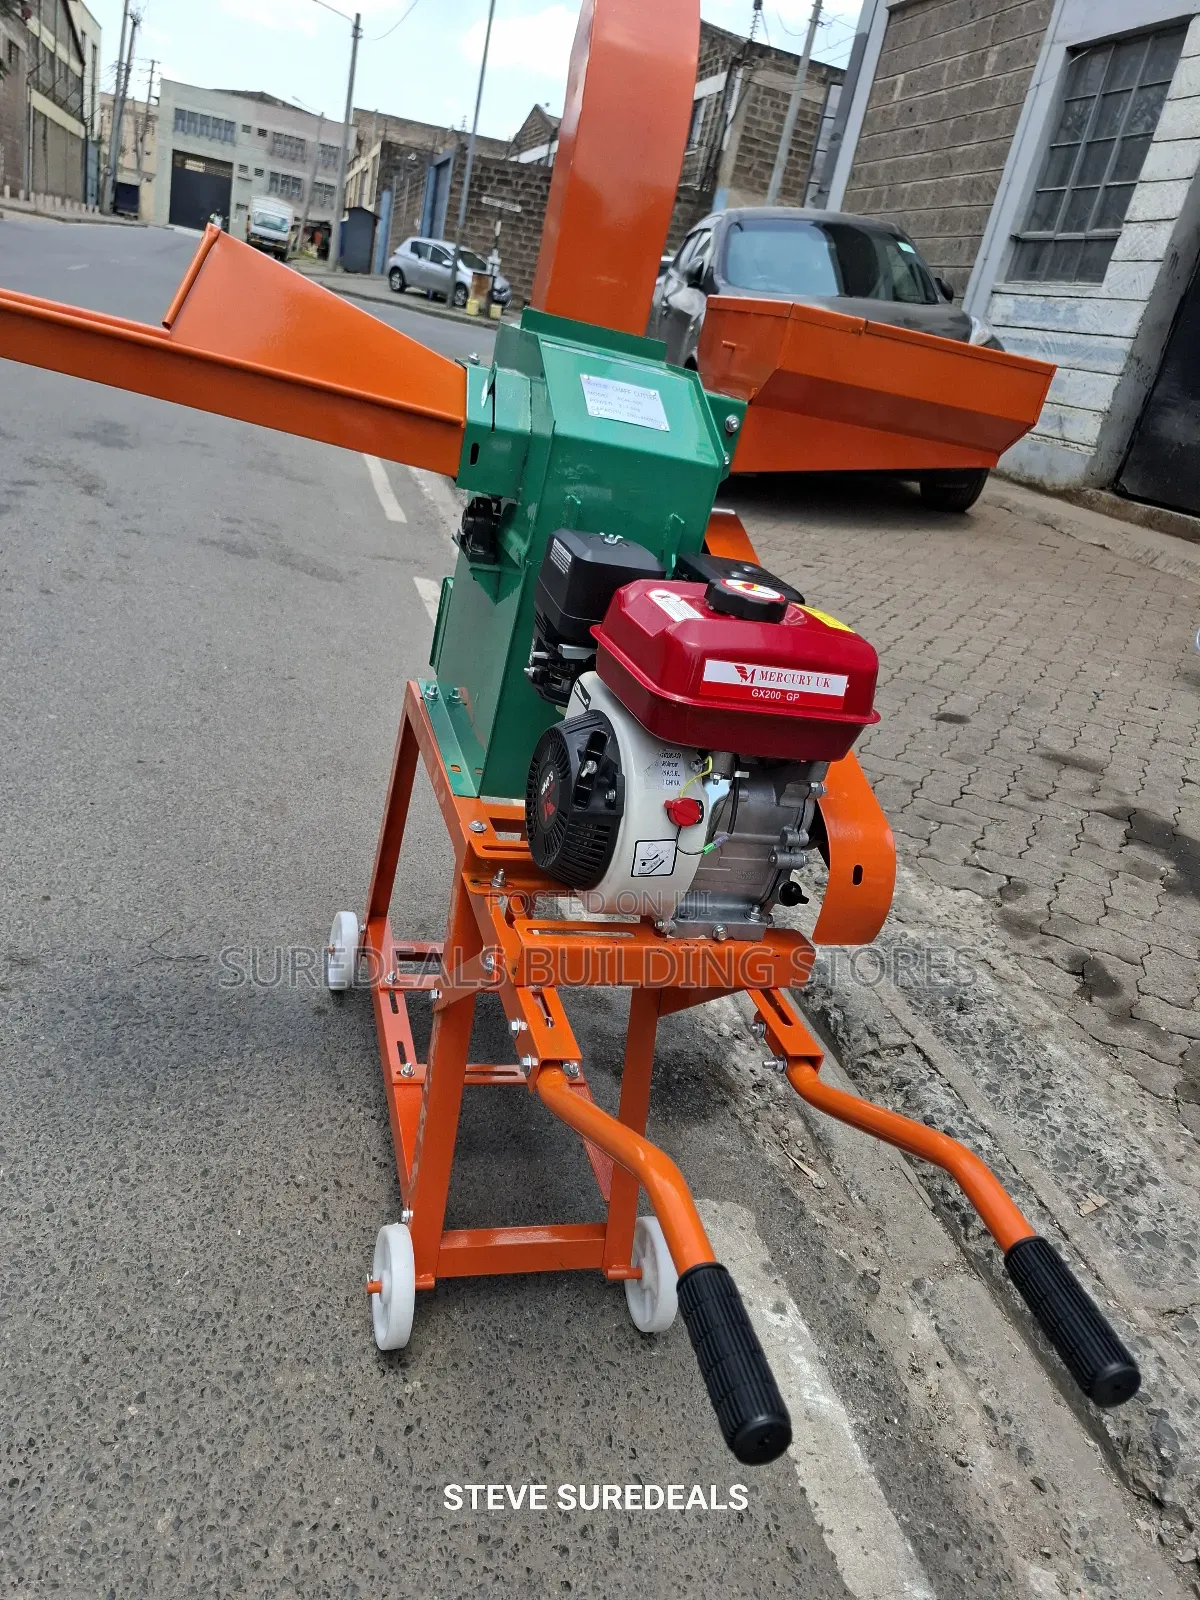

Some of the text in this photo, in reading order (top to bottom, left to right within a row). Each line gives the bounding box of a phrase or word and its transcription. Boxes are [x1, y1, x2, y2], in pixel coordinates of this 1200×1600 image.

[759, 670, 813, 686] MERCURY
[816, 676, 832, 688] UK
[751, 689, 800, 702] GX200 GP
